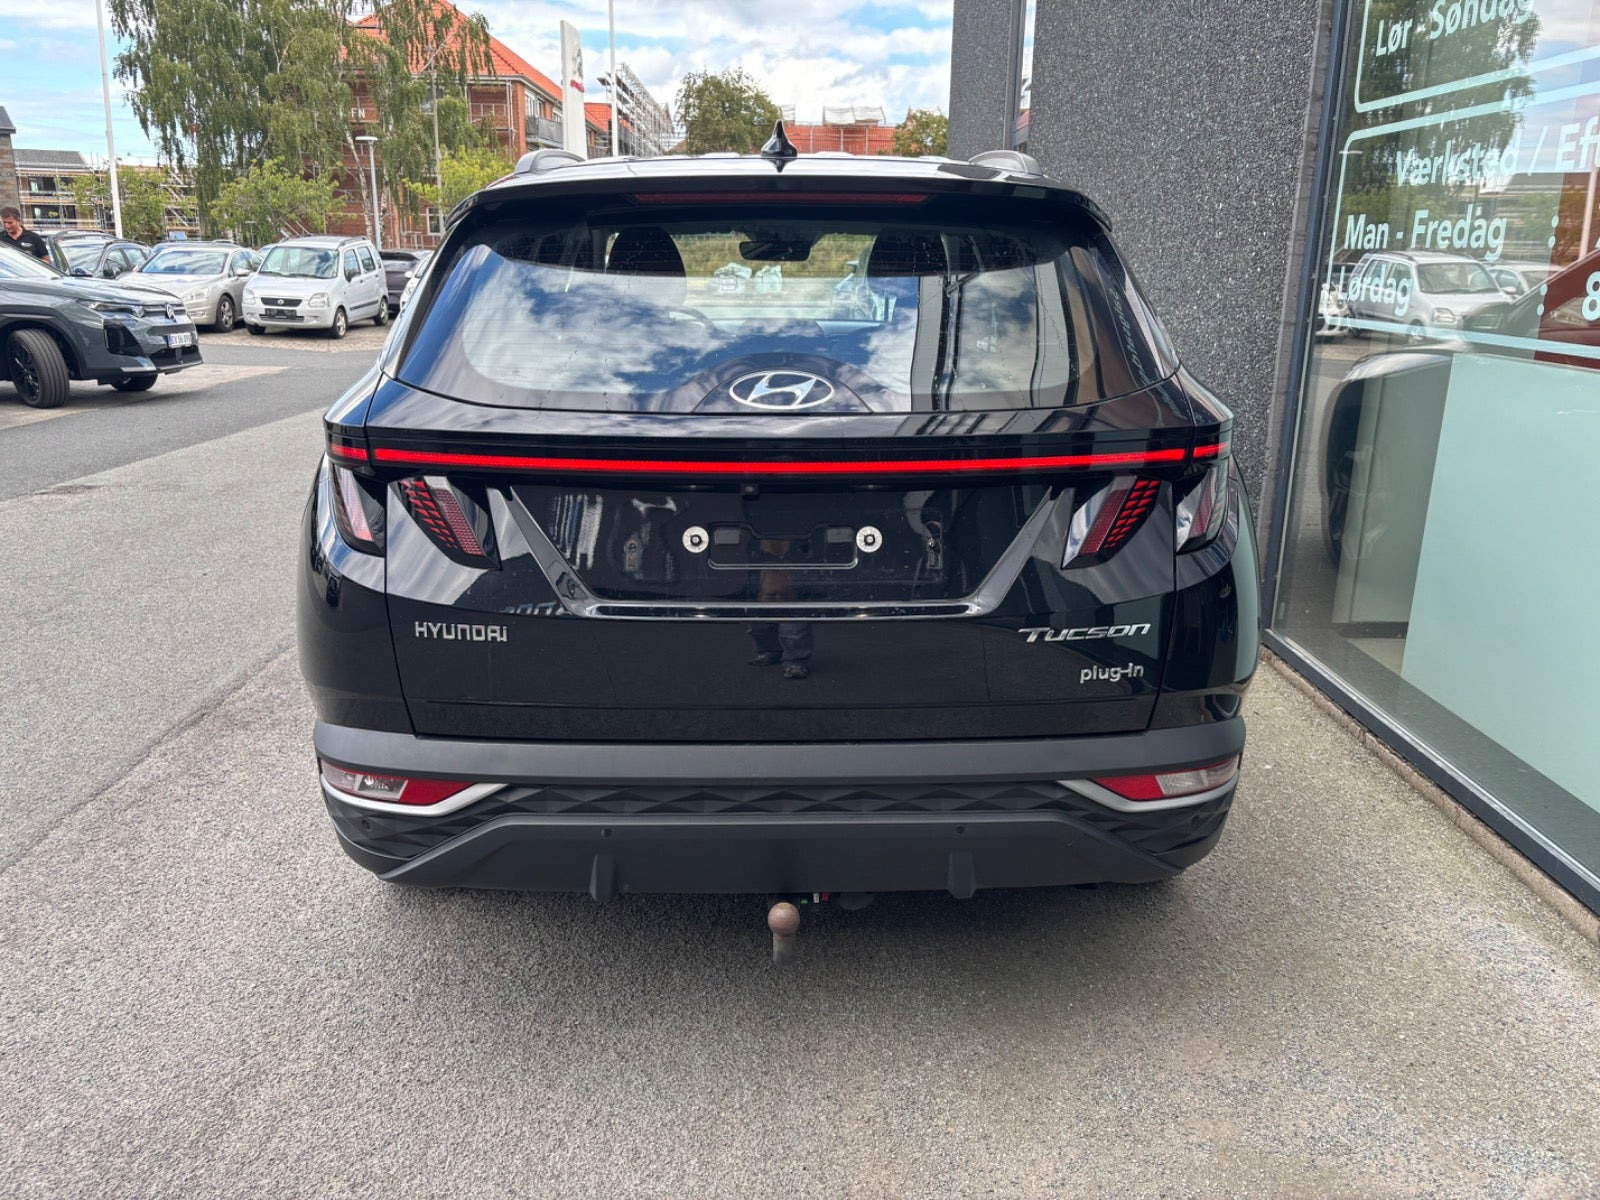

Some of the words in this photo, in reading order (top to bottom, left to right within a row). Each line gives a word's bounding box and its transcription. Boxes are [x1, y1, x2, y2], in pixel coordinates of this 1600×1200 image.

[1376, 18, 1412, 57] Lør
[1430, 0, 1535, 41] Søndag
[1396, 127, 1522, 188] Værksted
[1527, 125, 1548, 176] /
[1343, 213, 1390, 250] Man
[1395, 231, 1404, 240] -
[1410, 204, 1508, 262] Fredag
[1337, 264, 1413, 317] Lørdag
[414, 621, 508, 642] HYUNDAI
[1079, 662, 1145, 685] plug-in
